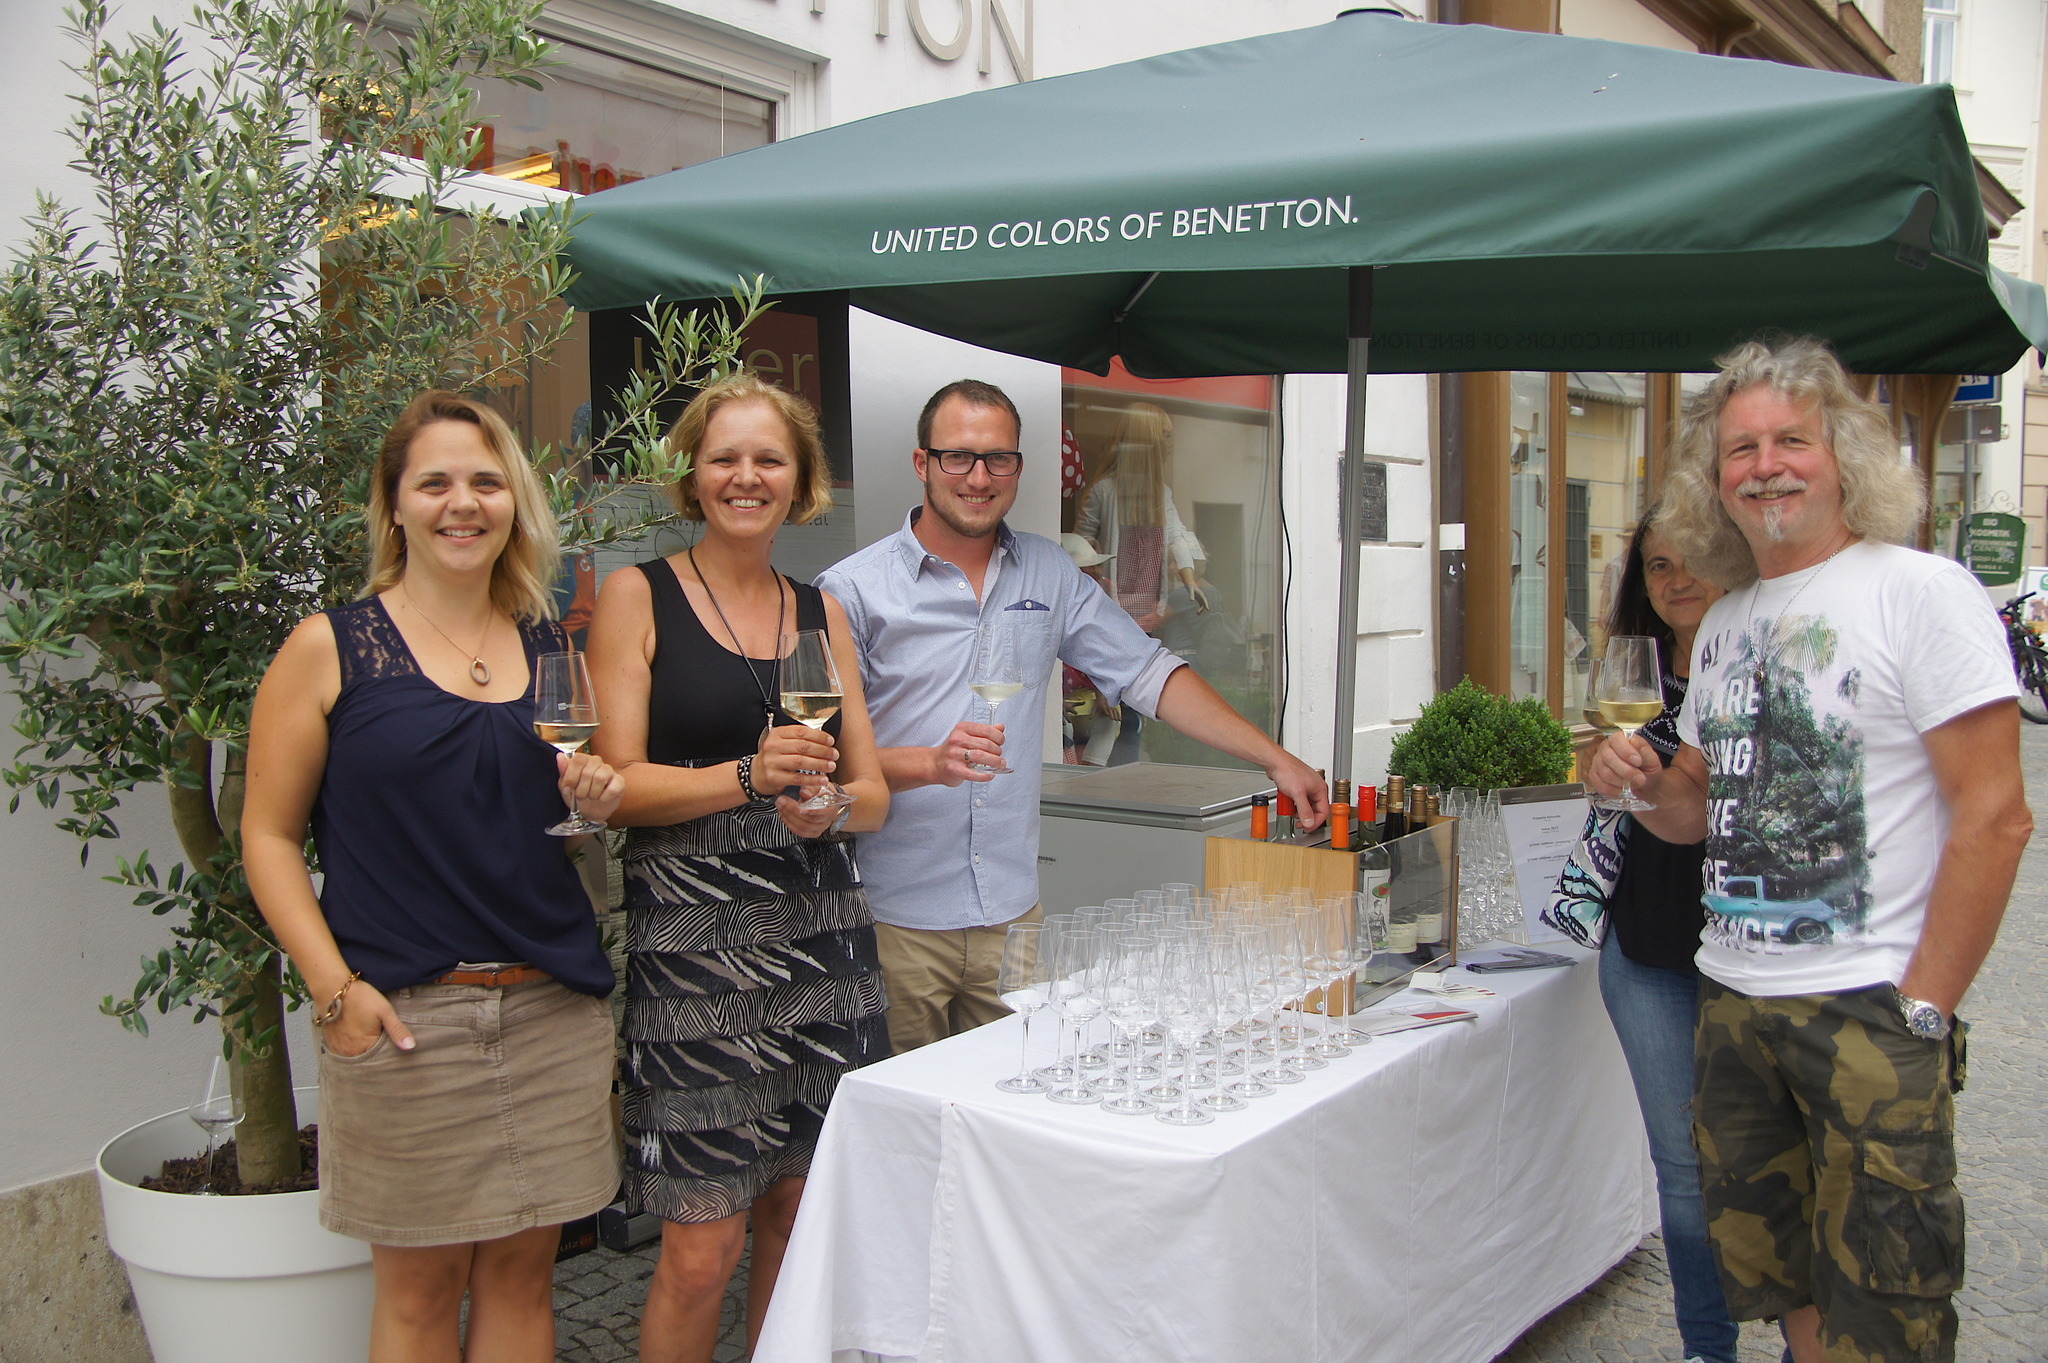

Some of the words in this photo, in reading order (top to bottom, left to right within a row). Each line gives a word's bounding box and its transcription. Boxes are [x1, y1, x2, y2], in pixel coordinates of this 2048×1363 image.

[871, 225, 978, 254] UNITED
[987, 216, 1110, 249] COLORS
[1120, 212, 1163, 240] OF
[1172, 195, 1358, 237] BENETTON.
